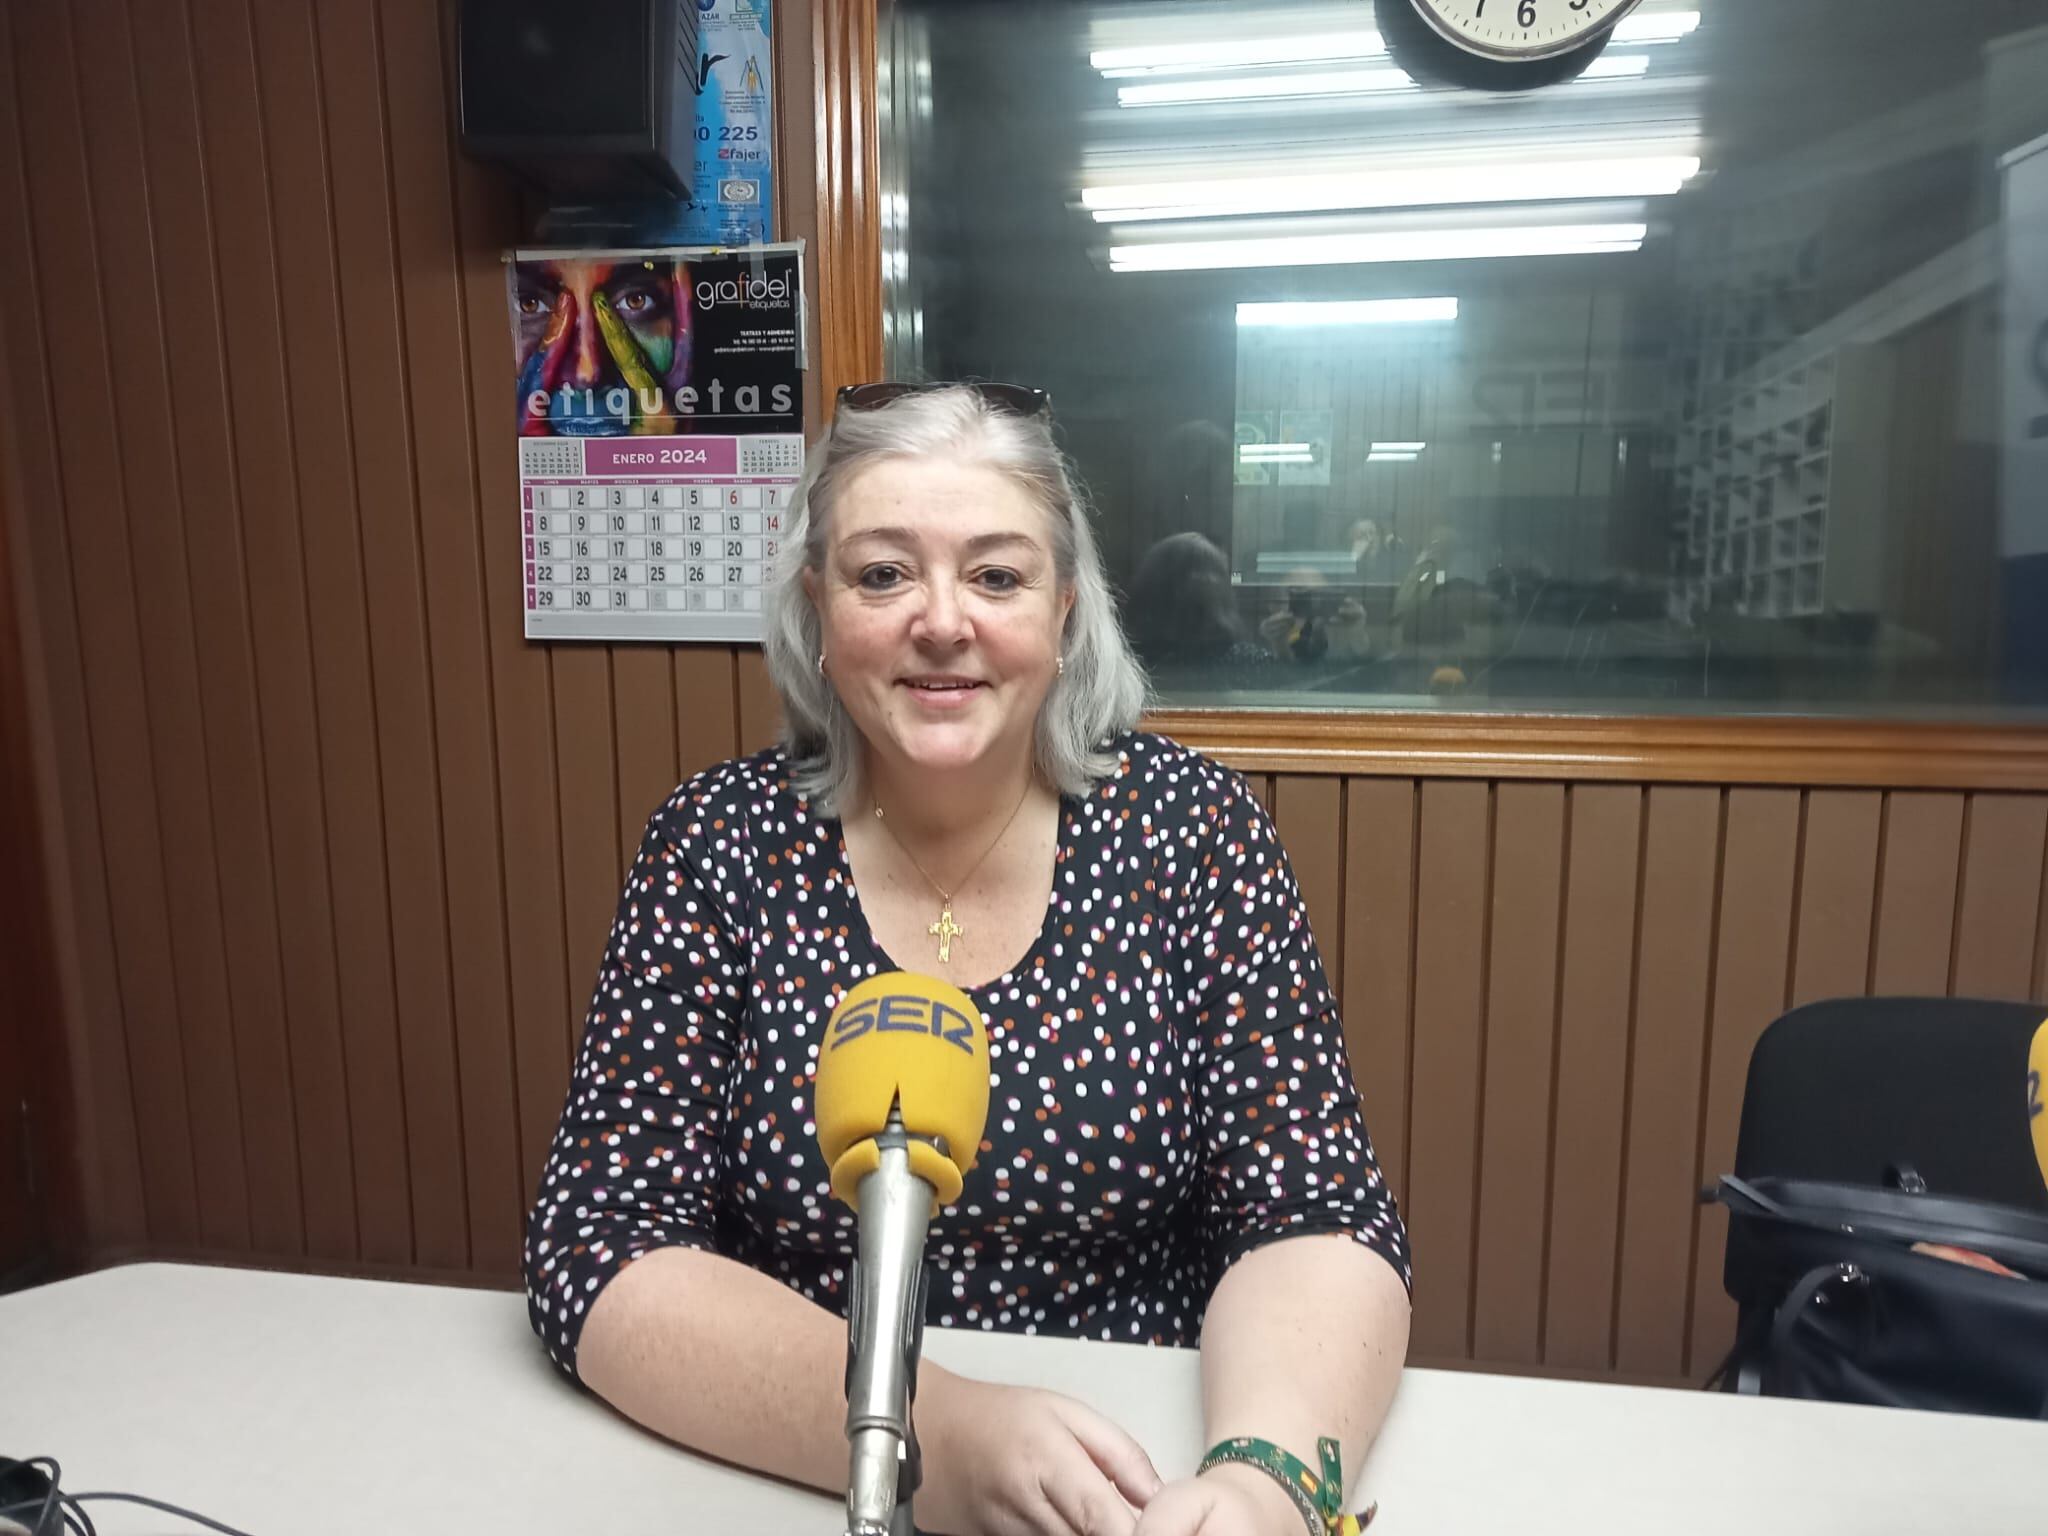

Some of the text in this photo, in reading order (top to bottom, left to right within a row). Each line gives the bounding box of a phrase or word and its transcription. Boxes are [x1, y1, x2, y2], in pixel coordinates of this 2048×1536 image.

[1517, 0, 1536, 28] 6
[694, 126, 758, 141] 0 225
[730, 148, 761, 162] fajer
[696, 270, 790, 310] grafidel
[527, 378, 793, 425] etiquetas
[612, 449, 708, 465] ENERO 2024
[539, 491, 545, 506] 1
[577, 490, 585, 506] 2
[614, 490, 621, 505] 3
[651, 490, 659, 505] 4
[690, 490, 698, 505] 5
[730, 490, 738, 505] 6
[769, 490, 776, 505] 7
[539, 516, 547, 531] 8
[577, 516, 585, 531] 9
[612, 516, 625, 531] 10
[652, 515, 660, 531] 11
[689, 515, 701, 531] 12
[729, 516, 740, 531] 13
[767, 515, 778, 531] 14
[538, 541, 550, 556] 15
[576, 541, 588, 556] 16
[613, 541, 625, 556] 17
[651, 541, 663, 556] 18
[689, 541, 702, 556] 19
[727, 541, 743, 556] 20
[538, 566, 552, 581] 22
[575, 566, 590, 581] 23
[613, 566, 627, 581] 24
[651, 566, 665, 581] 25
[689, 566, 704, 582] 26
[728, 566, 742, 582] 27
[765, 567, 776, 582] 2
[538, 591, 553, 606] 29
[576, 591, 591, 606] 30
[615, 592, 627, 606] 31
[831, 995, 974, 1056] SER
